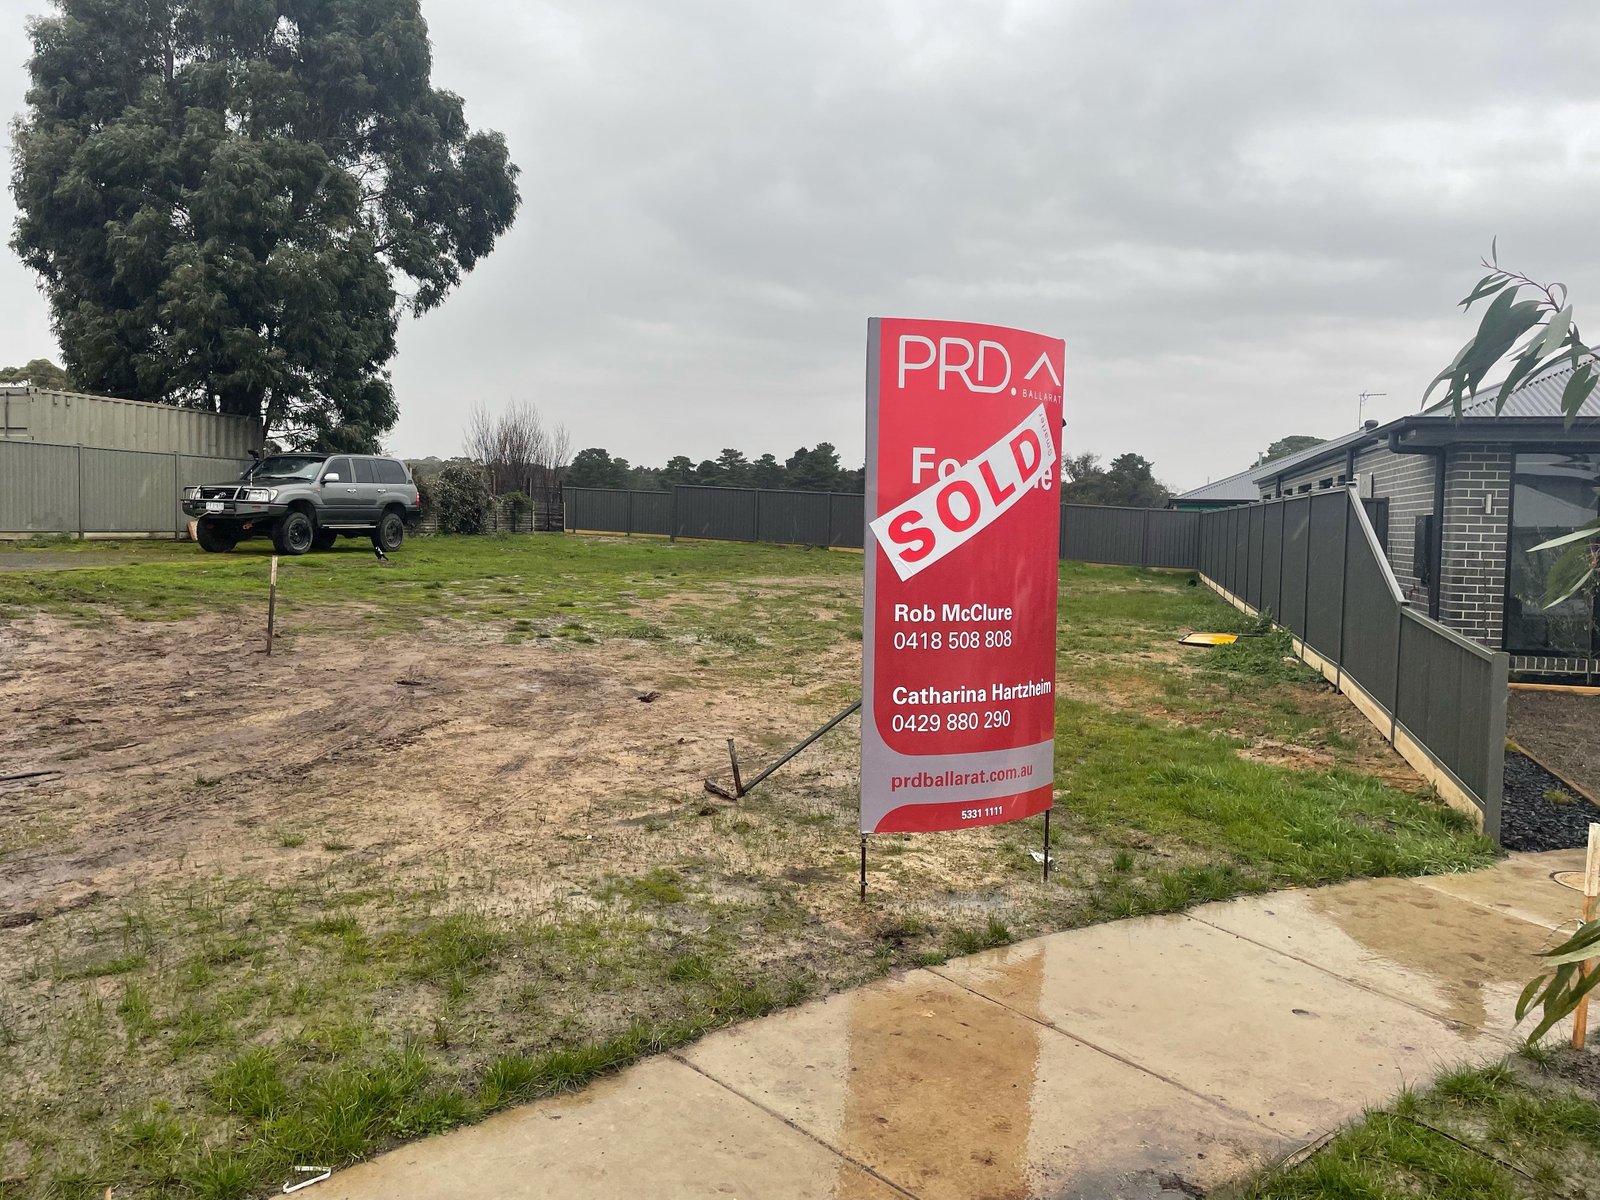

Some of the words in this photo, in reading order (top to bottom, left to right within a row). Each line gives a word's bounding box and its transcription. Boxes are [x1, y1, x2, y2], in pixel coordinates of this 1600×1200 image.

[1022, 389, 1062, 404] BALLARAT
[911, 446, 975, 484] Fo
[887, 428, 1042, 563] SOLD
[893, 603, 936, 623] Rob
[941, 603, 1013, 622] McClure
[893, 631, 942, 650] 0418
[949, 631, 980, 649] 508
[985, 630, 1012, 648] 808
[892, 685, 987, 705] Catharina
[992, 678, 1051, 701] Hartzheim
[891, 714, 941, 732] 0429
[946, 713, 979, 731] 880
[984, 710, 1011, 728] 290
[891, 763, 1033, 792] prdballarat.com.au
[961, 808, 982, 820] 5331
[985, 805, 1003, 817] 1111
